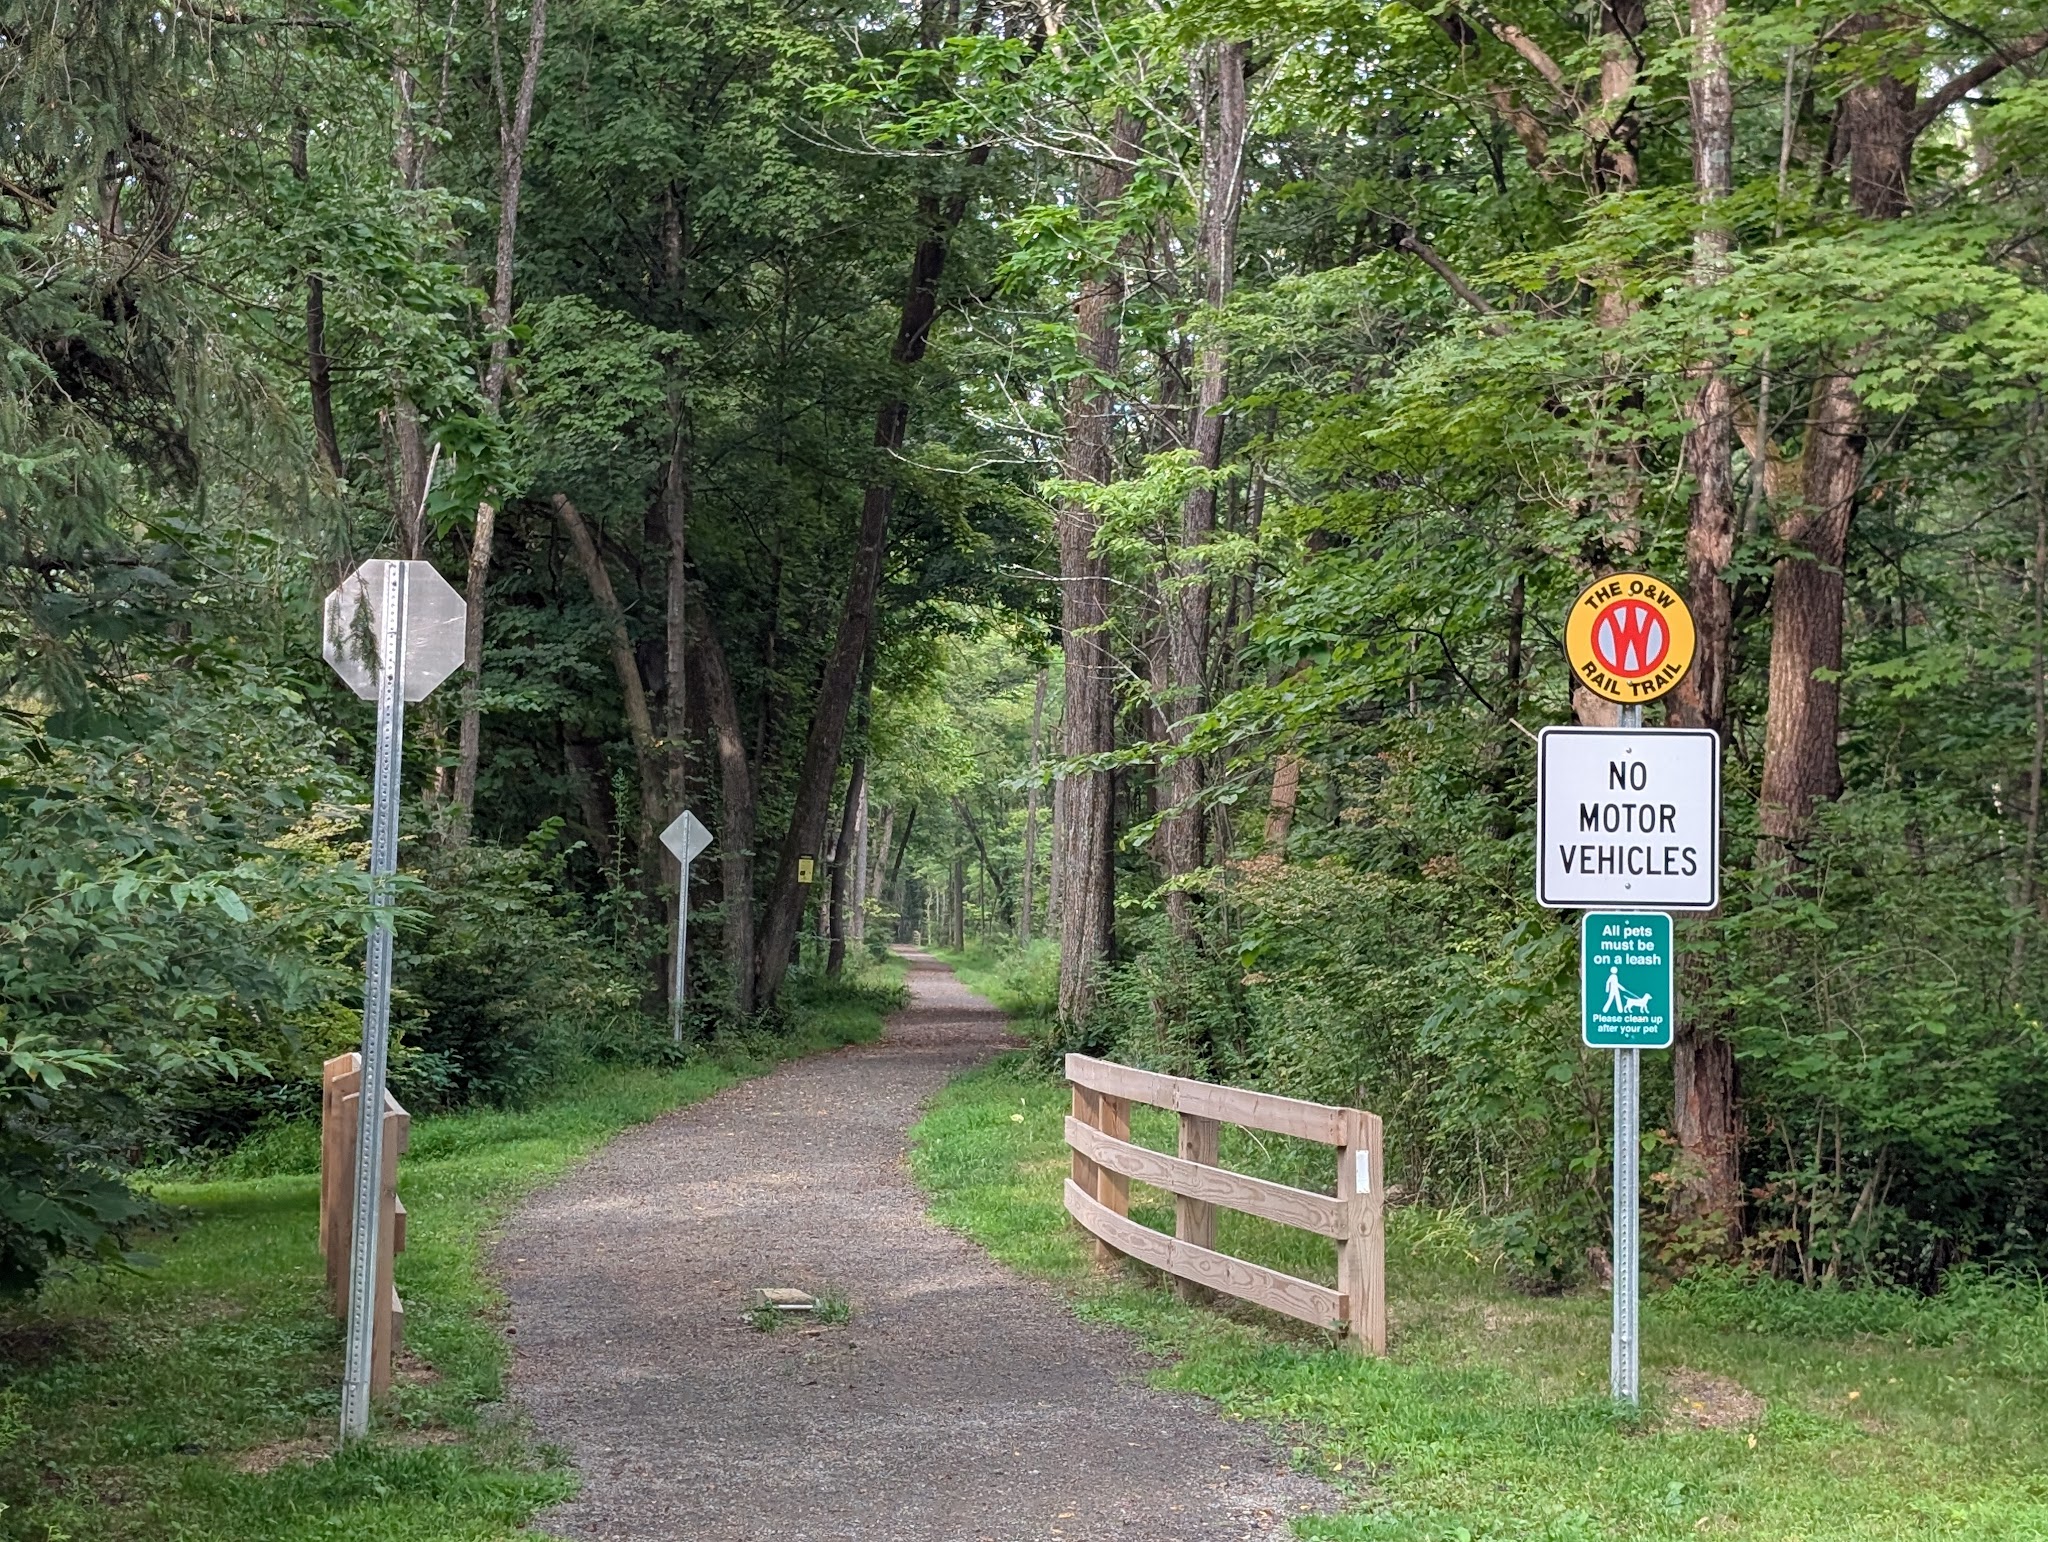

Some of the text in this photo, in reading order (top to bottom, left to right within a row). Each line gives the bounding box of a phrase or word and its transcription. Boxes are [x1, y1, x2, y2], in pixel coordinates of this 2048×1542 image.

[1584, 581, 1675, 609] THE O&W
[1581, 661, 1682, 696] RAIL TRAIL
[1609, 761, 1647, 791] NO
[1579, 803, 1676, 833] MOTOR
[1559, 845, 1697, 876] VEHICLES
[1602, 924, 1653, 939] All pets
[1601, 939, 1655, 951] must be
[1593, 953, 1662, 965] on a leash
[1592, 1013, 1663, 1025] Please clean up
[1597, 1024, 1658, 1034] after your pet
